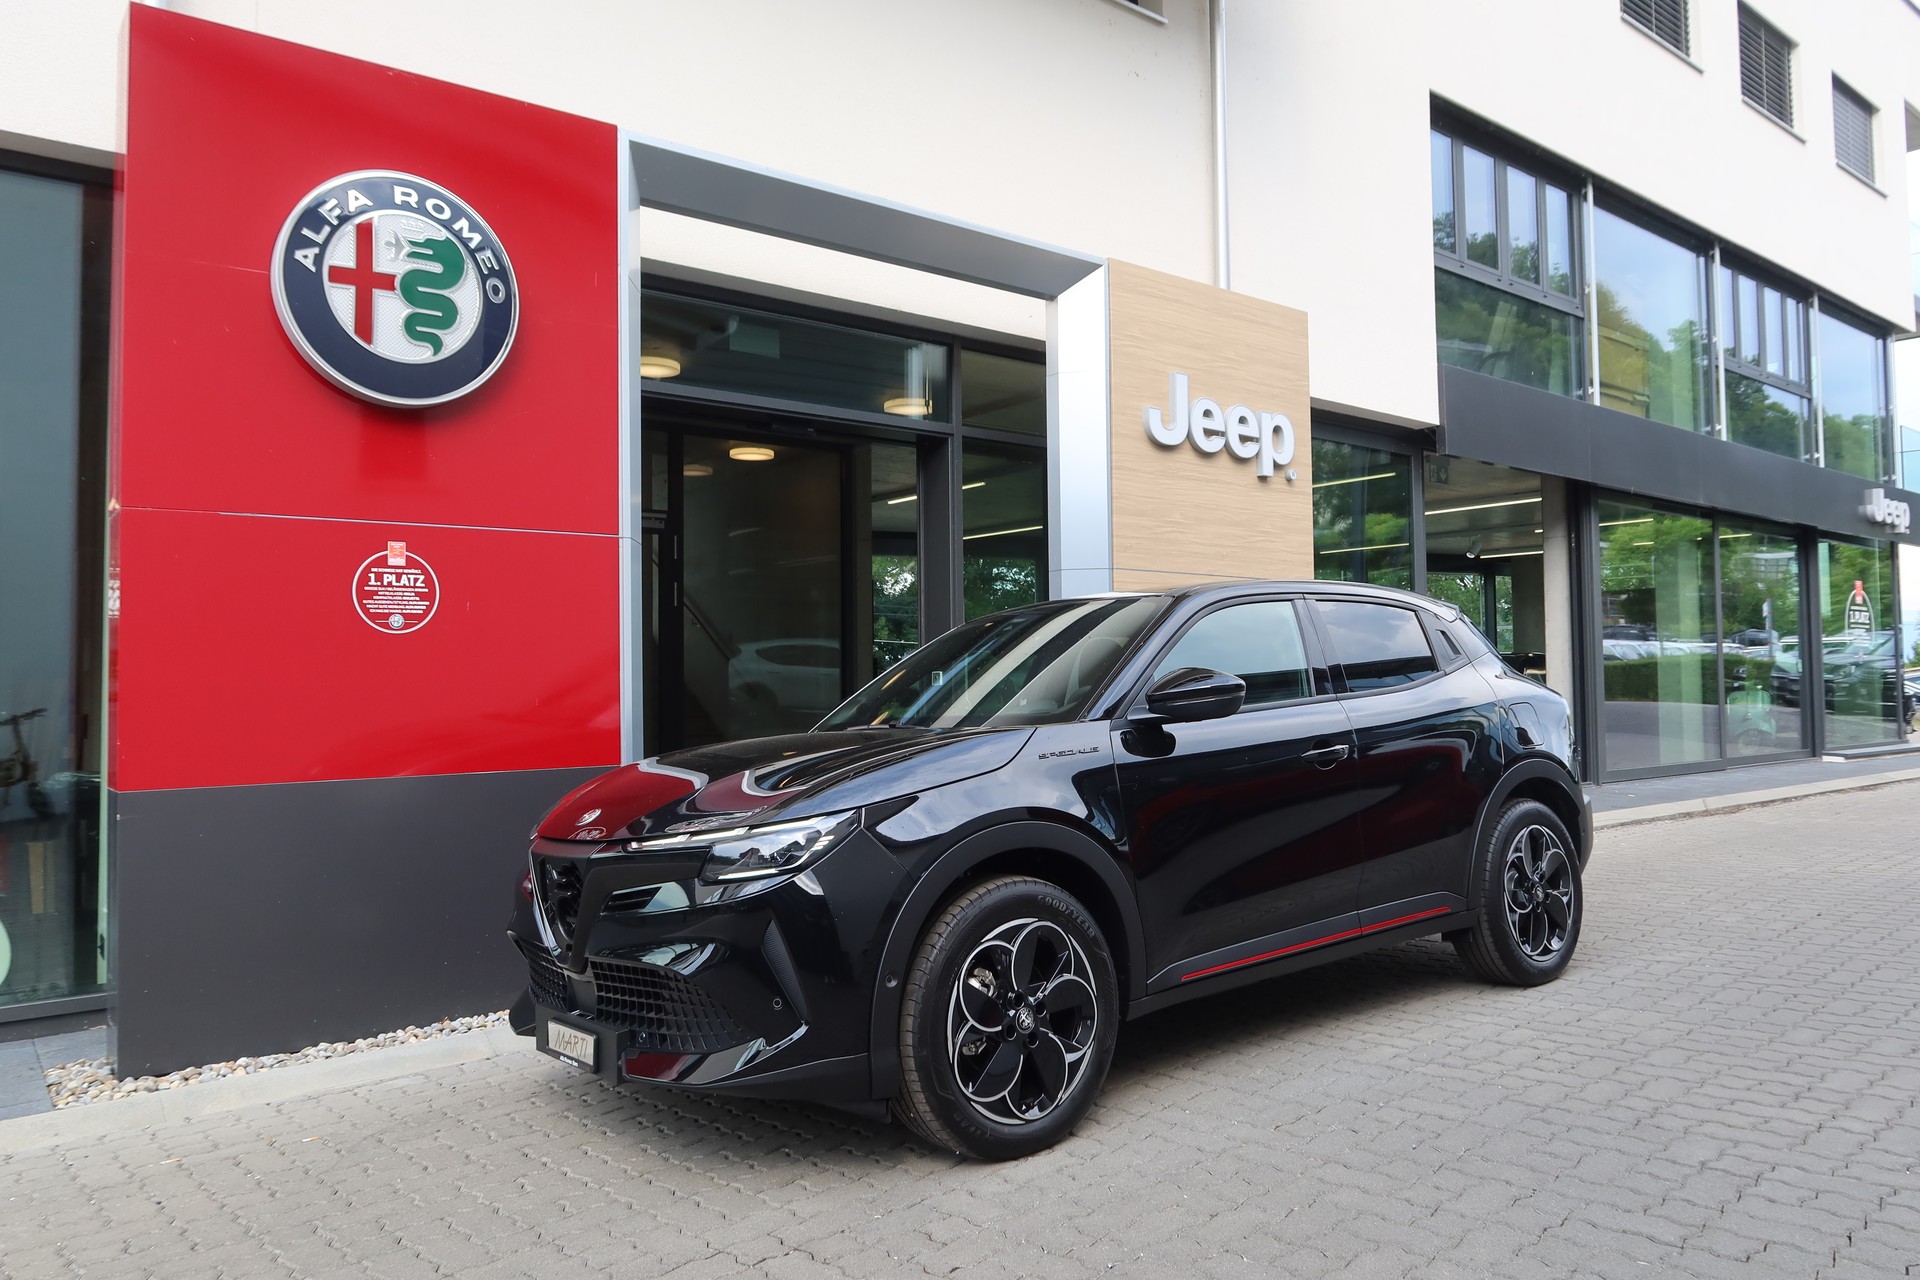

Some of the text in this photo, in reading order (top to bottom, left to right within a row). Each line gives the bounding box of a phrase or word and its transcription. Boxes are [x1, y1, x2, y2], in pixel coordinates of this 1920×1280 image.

[294, 184, 506, 304] ALFA ROMEO
[1143, 371, 1295, 478] Jeep
[1866, 487, 1910, 534] Jeep
[368, 572, 426, 587] 1. PLATZ
